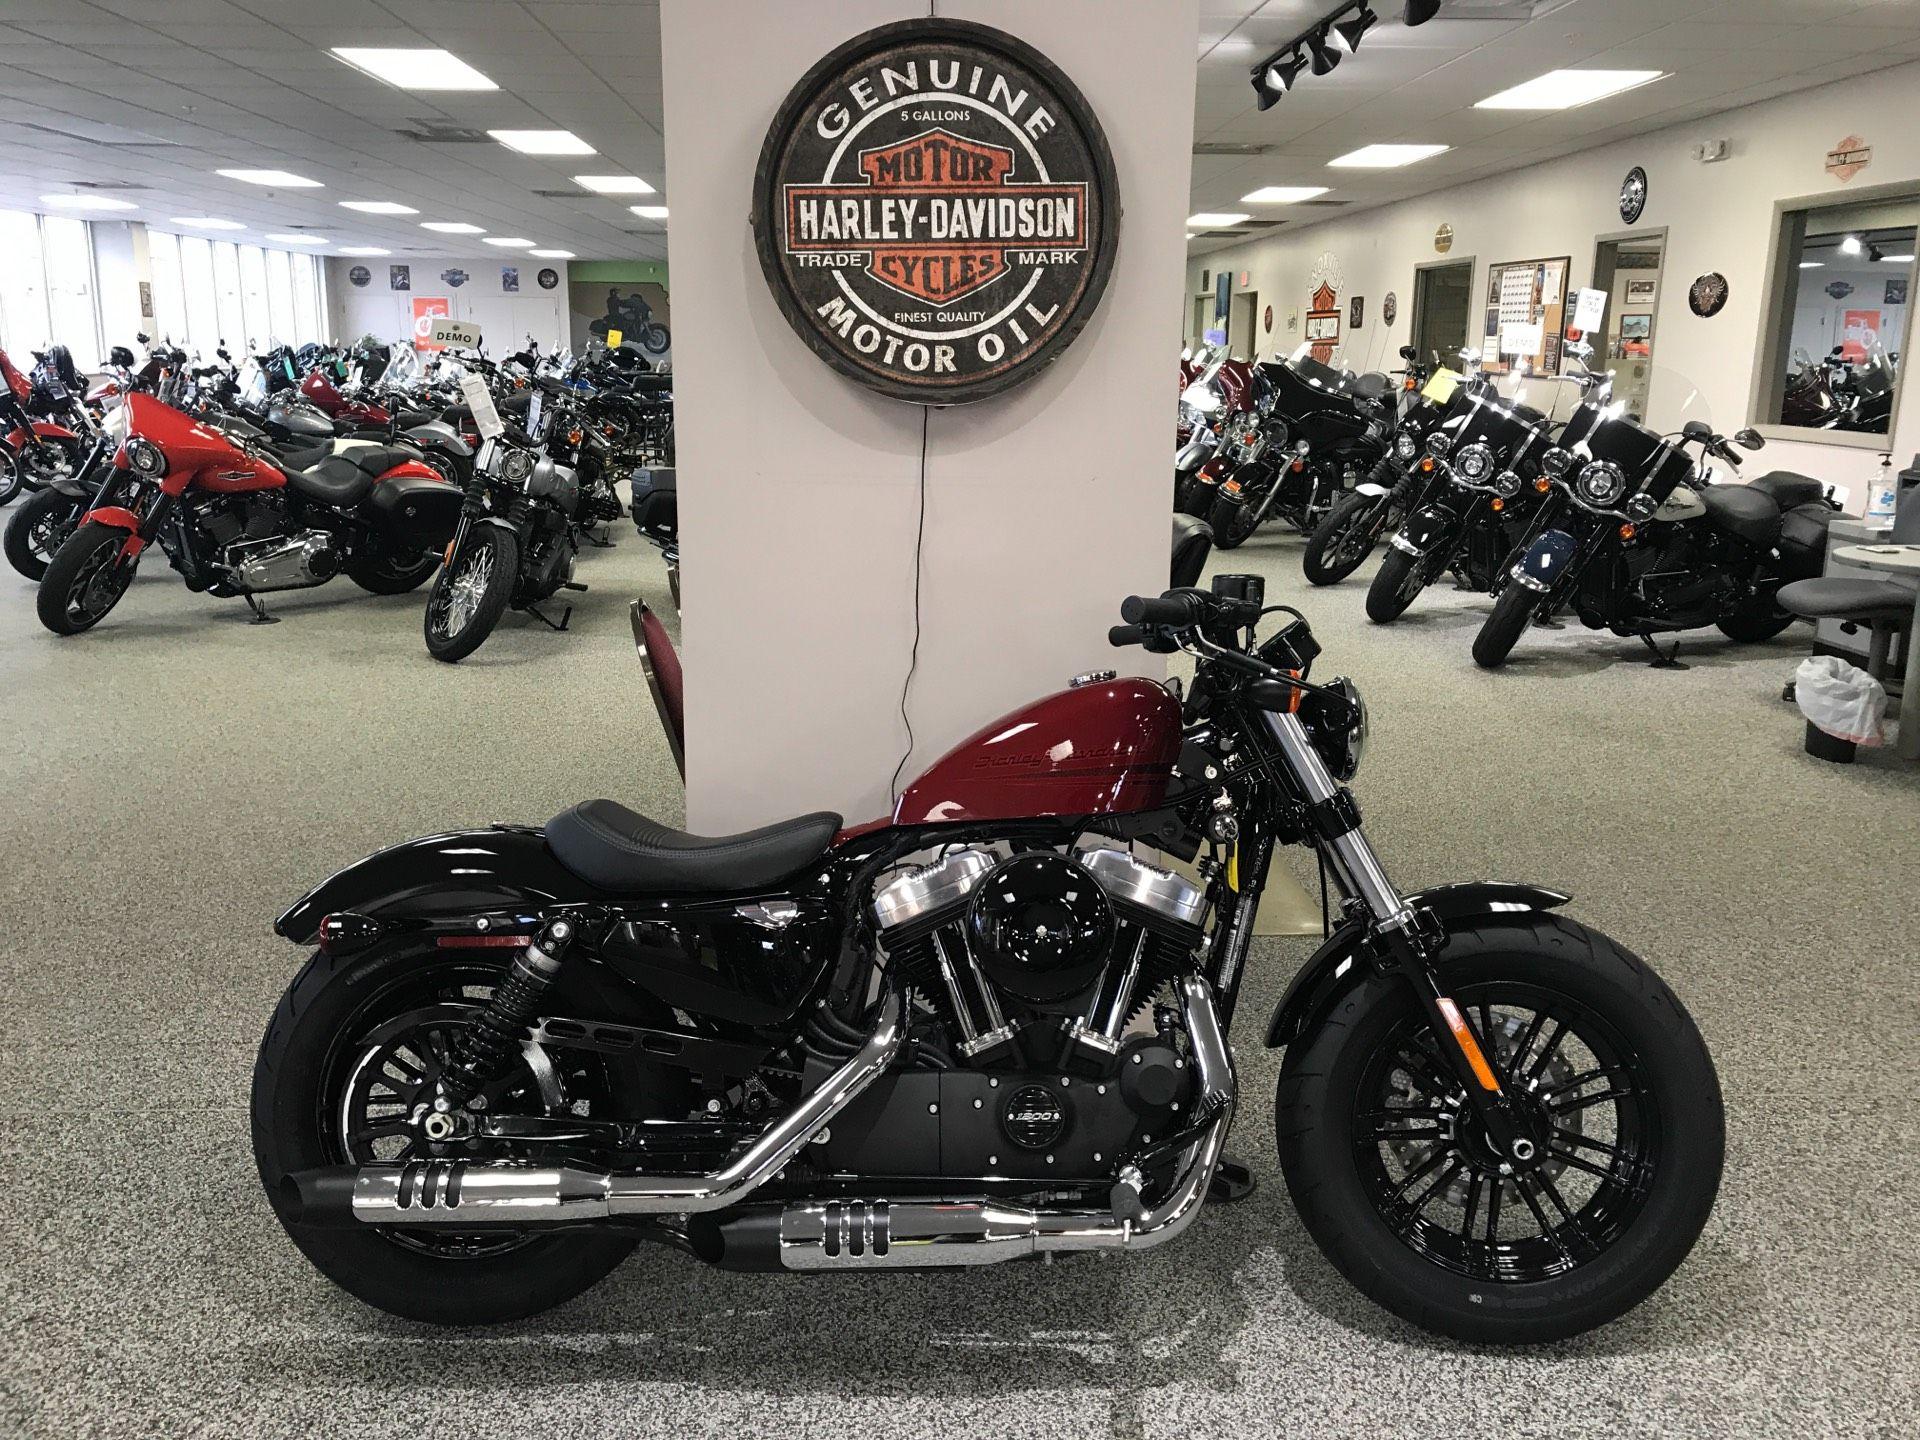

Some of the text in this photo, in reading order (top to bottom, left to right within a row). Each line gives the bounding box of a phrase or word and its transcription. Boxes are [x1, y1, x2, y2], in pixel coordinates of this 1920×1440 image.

[816, 60, 1056, 141] GENUINE
[901, 110, 971, 122] 5 GALLONS
[875, 140, 994, 183] MOTOR
[799, 197, 1075, 240] HARLEY-DAVIDSON
[796, 252, 1078, 267] TRADE MARK
[881, 255, 995, 294] CYCLES
[816, 296, 1059, 373] MOTOR OIL
[894, 310, 986, 324] FINEST QUALITY
[437, 332, 472, 343] DEMO
